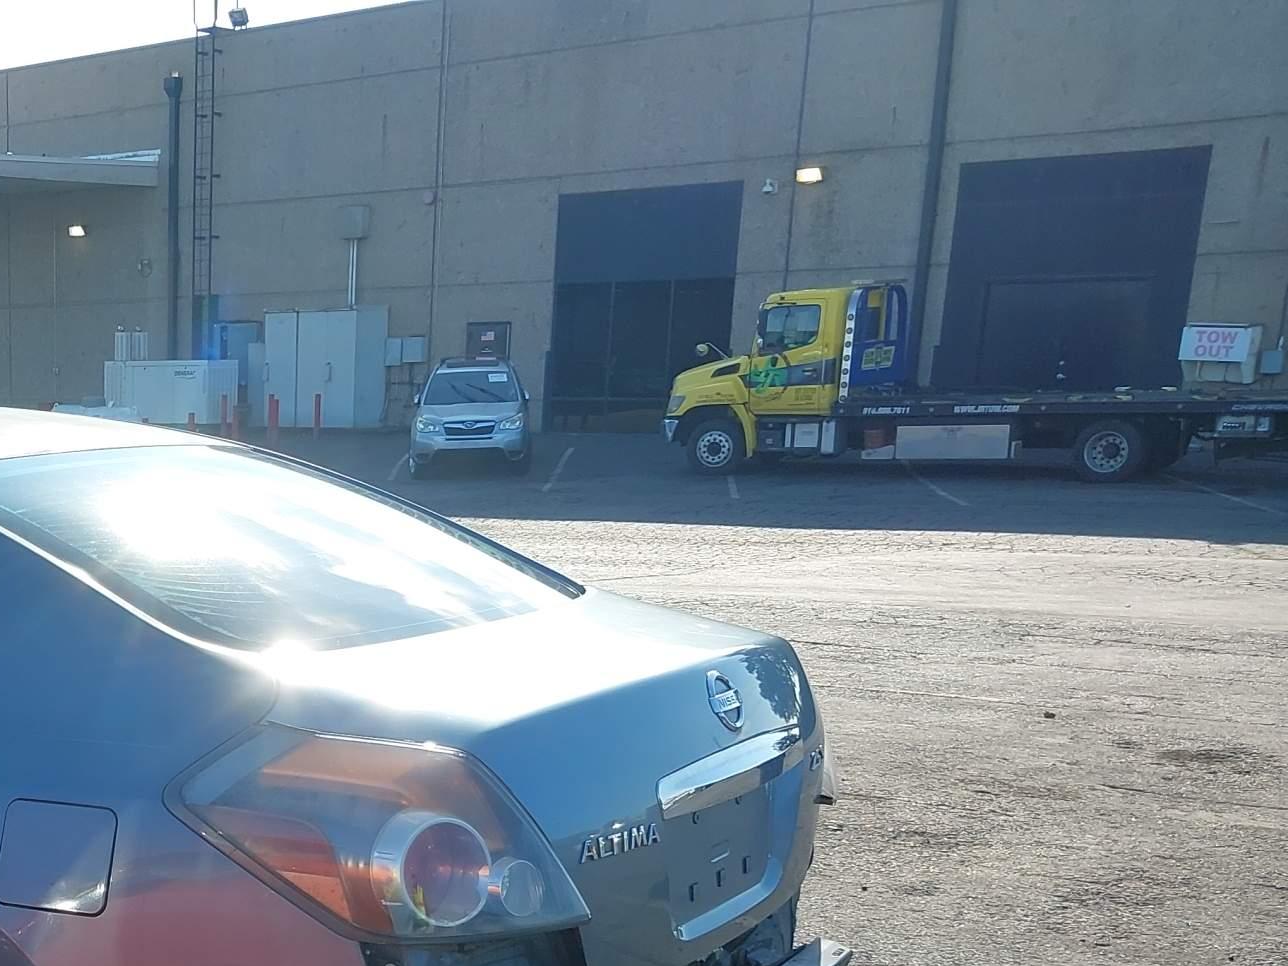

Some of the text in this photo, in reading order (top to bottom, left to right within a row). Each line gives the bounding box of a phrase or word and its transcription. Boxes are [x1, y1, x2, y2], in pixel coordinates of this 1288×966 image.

[1195, 330, 1238, 344] TOW
[1194, 345, 1234, 357] OUT
[580, 822, 661, 865] ALTIMA
